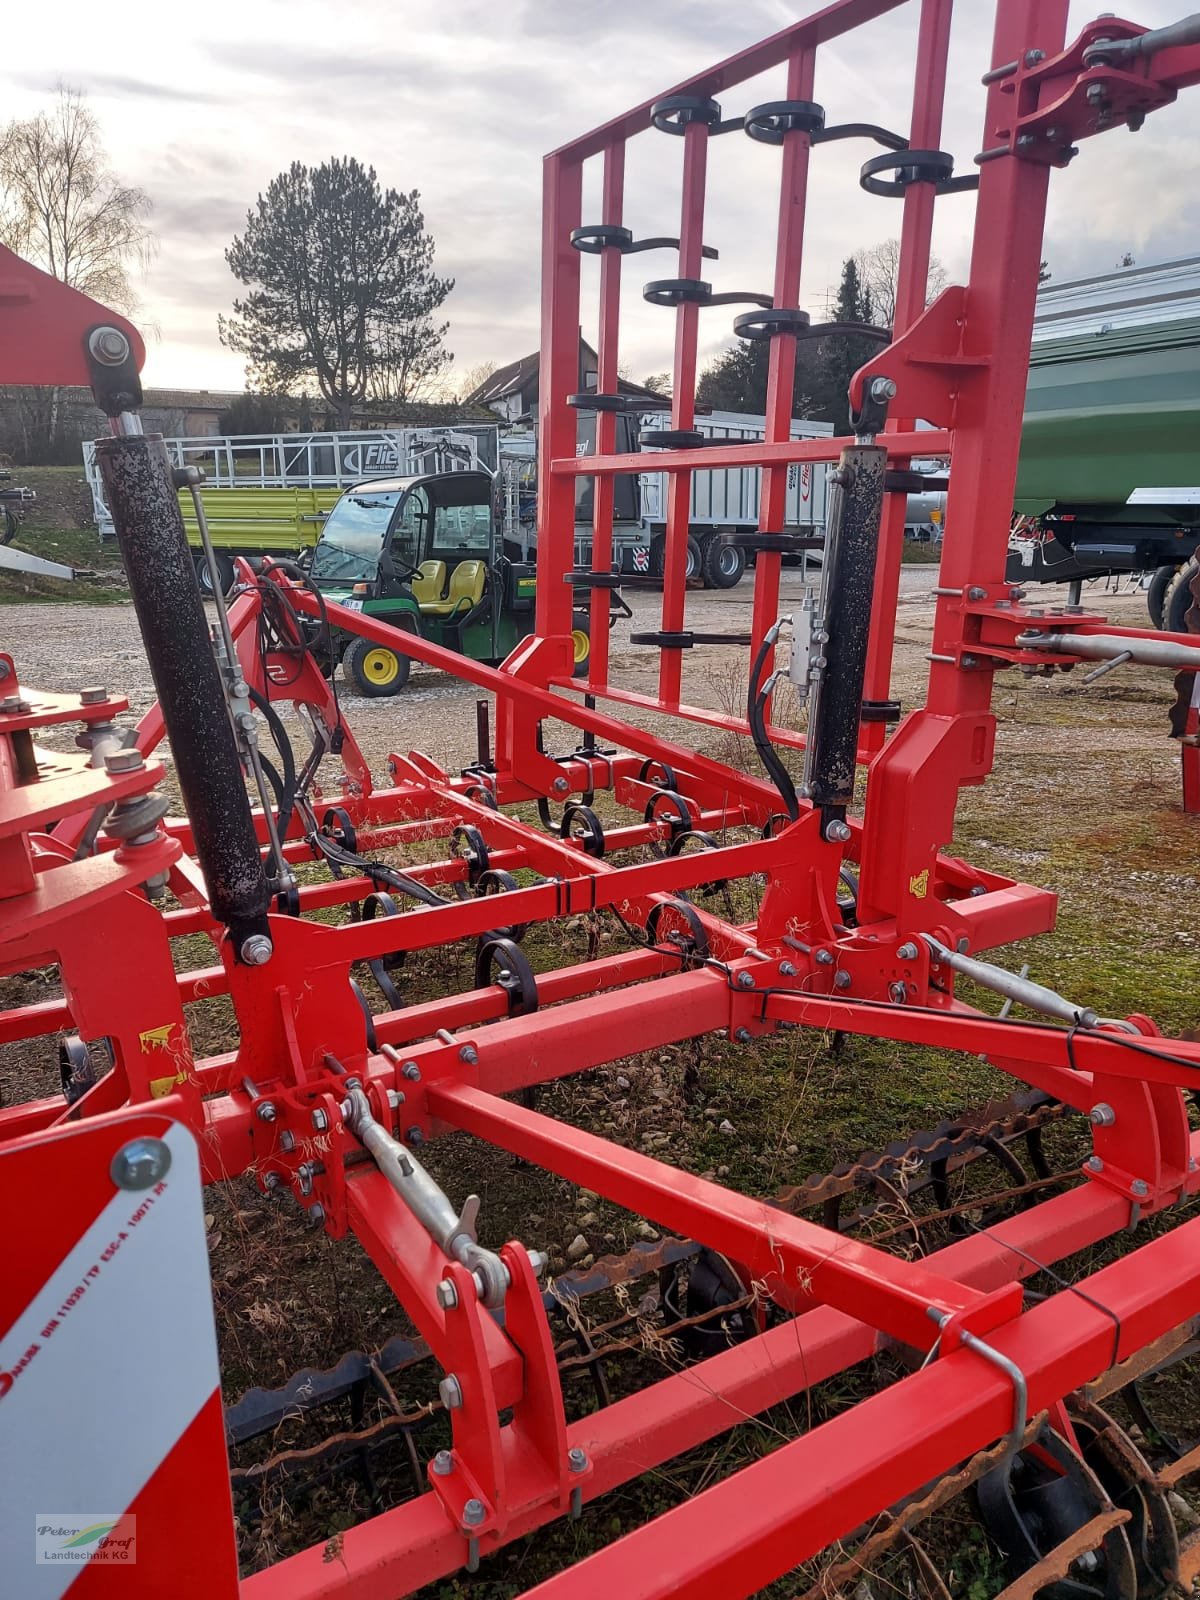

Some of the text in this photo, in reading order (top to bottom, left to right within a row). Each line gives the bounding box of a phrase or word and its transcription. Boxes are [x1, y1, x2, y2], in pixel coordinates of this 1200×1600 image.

[366, 445, 398, 465] Flie
[575, 440, 590, 458] egl
[801, 464, 810, 487] Flie
[40, 1319, 61, 1339] DIN
[57, 1286, 86, 1318] 11030
[86, 1264, 102, 1281] TP
[100, 1231, 129, 1262] ESC-A
[127, 1197, 155, 1228] 10071
